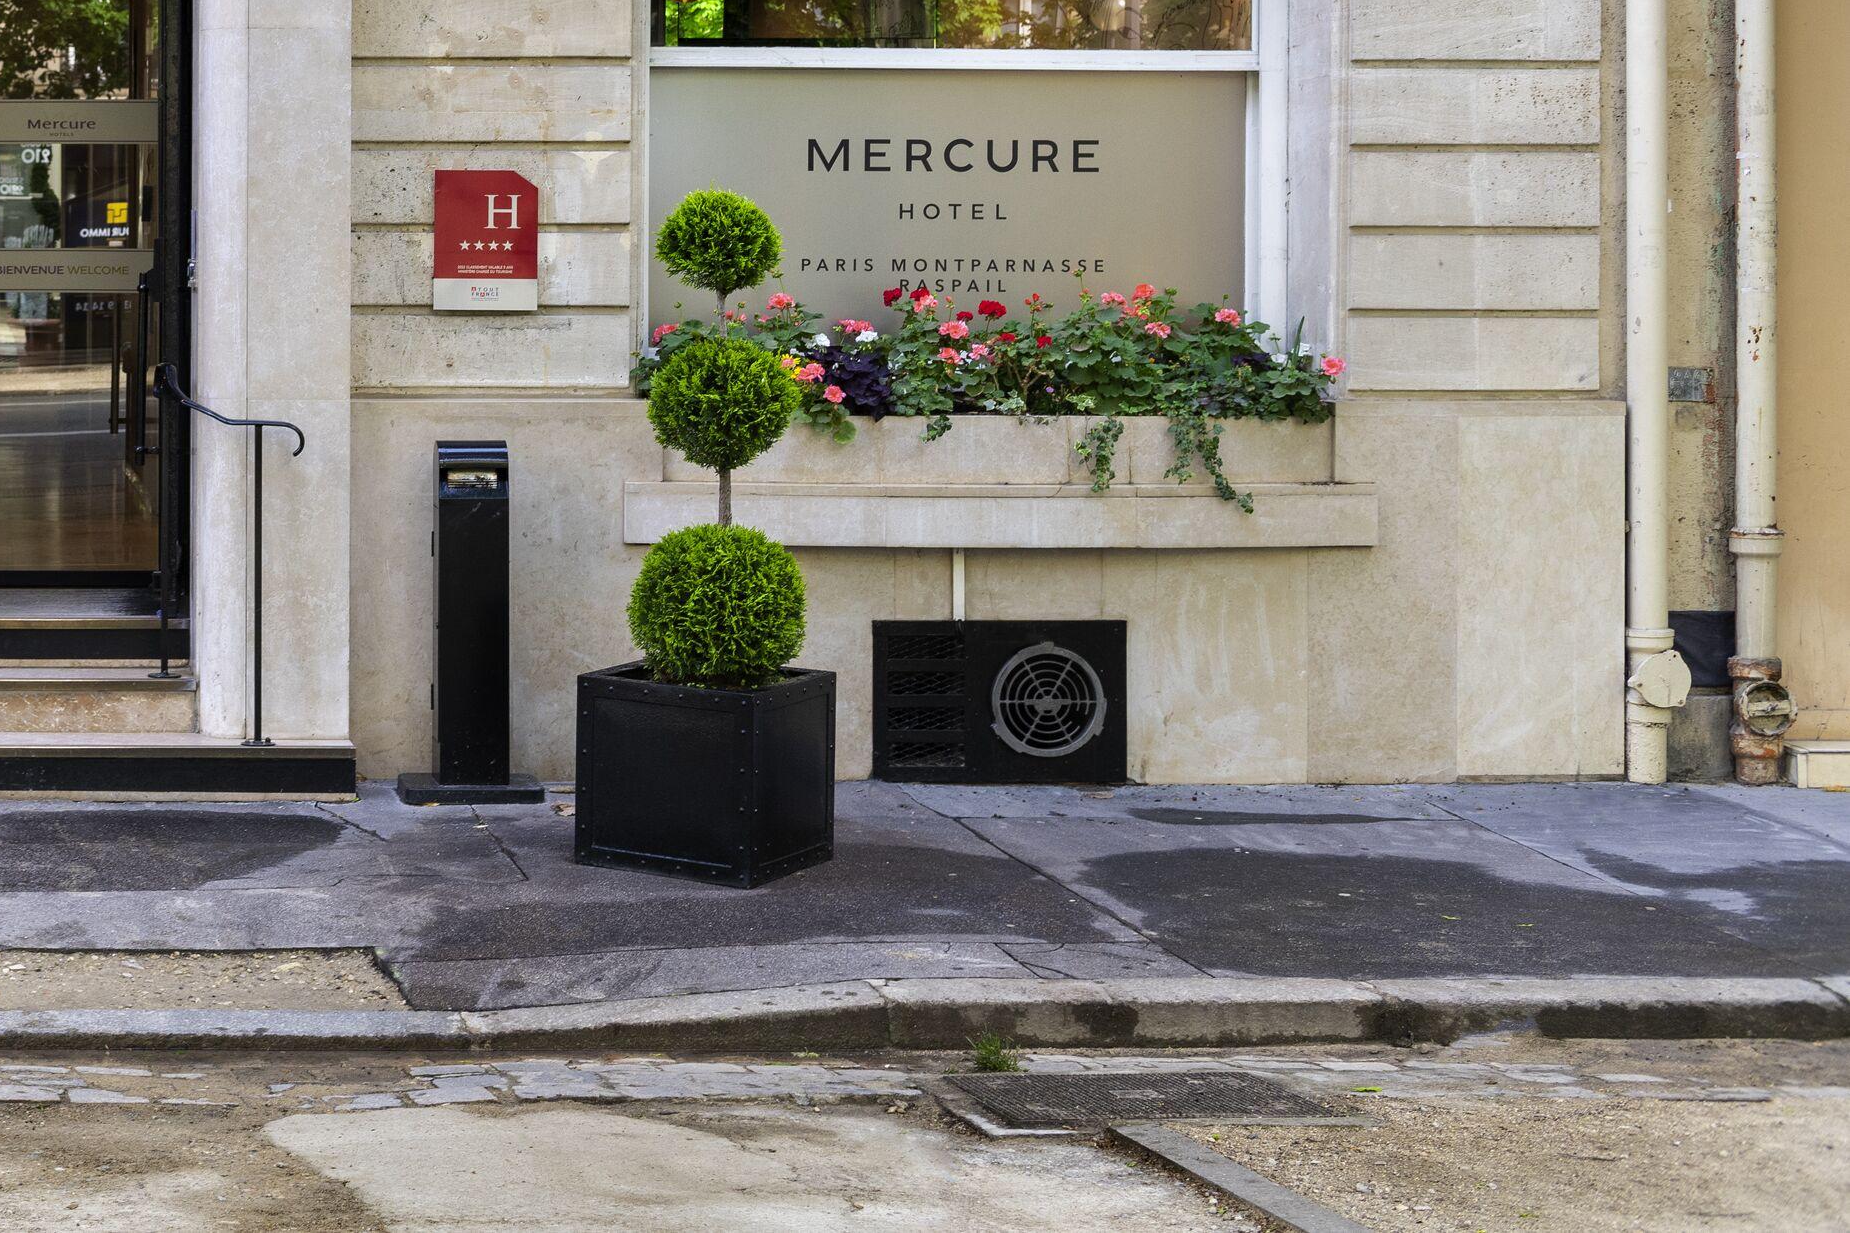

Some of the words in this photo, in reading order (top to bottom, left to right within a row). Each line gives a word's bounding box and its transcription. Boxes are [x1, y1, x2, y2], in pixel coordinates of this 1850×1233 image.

[26, 118, 97, 130] Mercure
[806, 138, 1101, 174] MERCURE
[483, 193, 522, 230] H
[899, 203, 1008, 220] HOTEL
[67, 264, 130, 276] WELCOME
[800, 257, 876, 272] PARIS
[891, 257, 1106, 273] MONTPARNASSE
[899, 279, 1008, 293] RASPAIL
